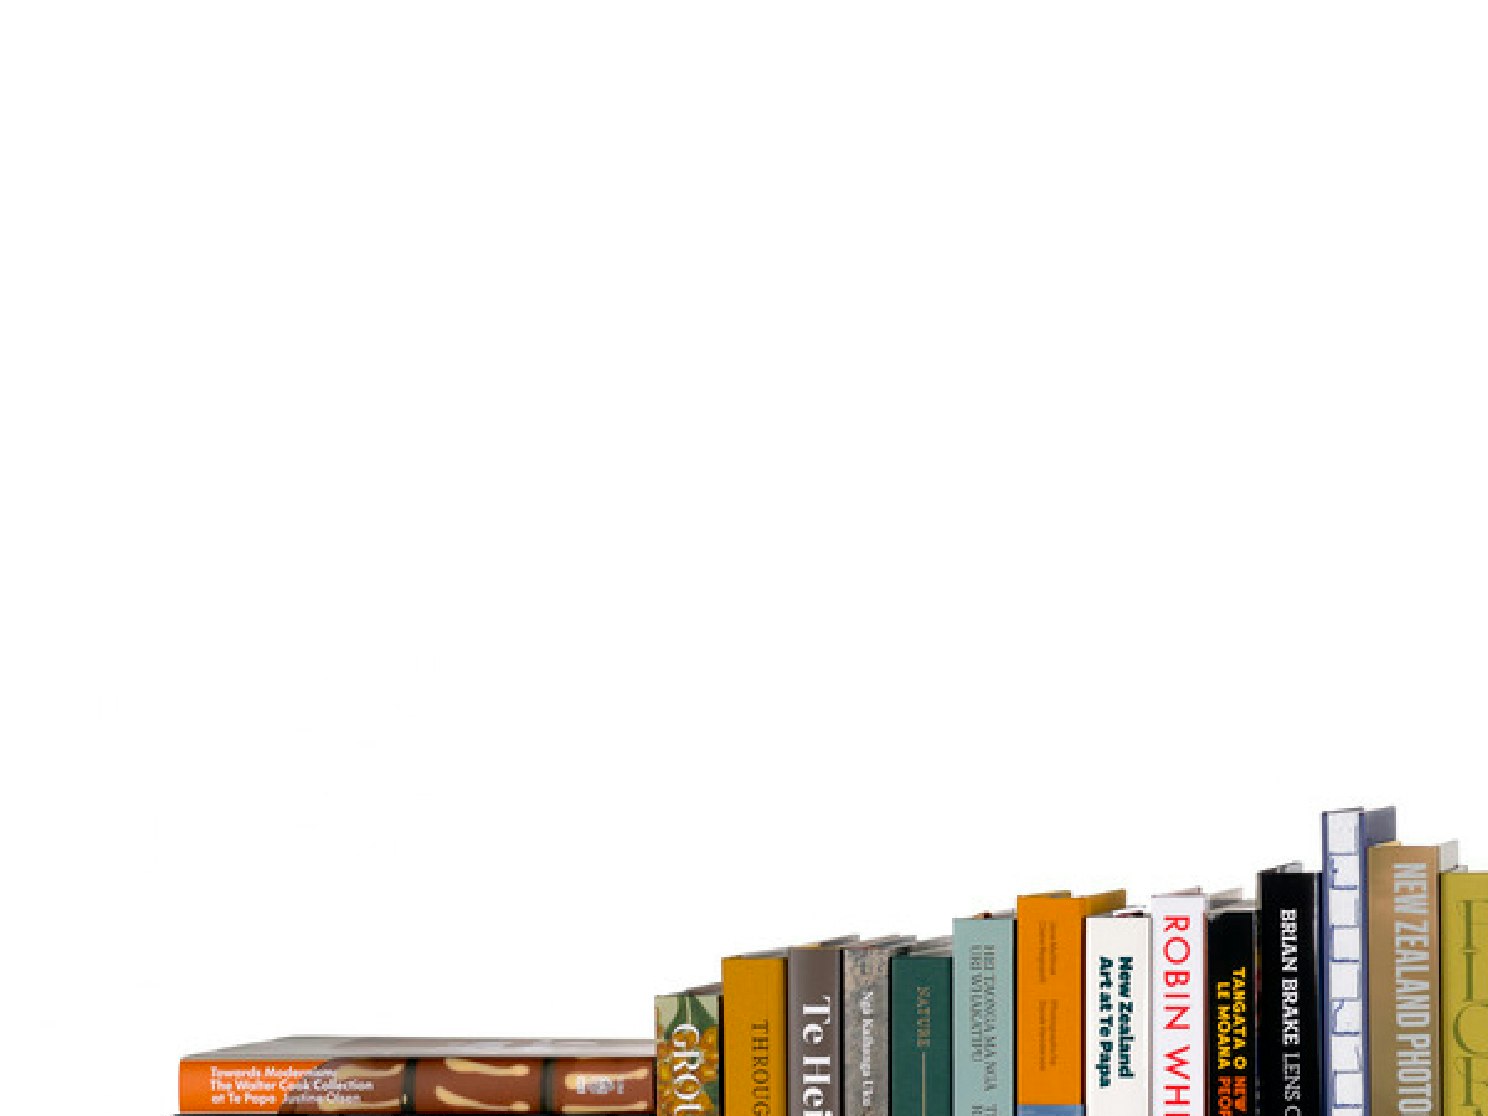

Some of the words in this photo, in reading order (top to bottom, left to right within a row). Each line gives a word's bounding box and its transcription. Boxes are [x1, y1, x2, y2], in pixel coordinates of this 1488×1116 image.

[1392, 863, 1429, 914] NEW
[1280, 908, 1298, 972] BRIAN
[1099, 956, 1113, 990] Art
[1118, 956, 1133, 998] New
[1163, 915, 1190, 1029] ROBIN
[1217, 981, 1230, 999] LE
[1394, 919, 1430, 1028] ZEALAND
[802, 994, 830, 1044] Te
[916, 986, 931, 1047] NATURE
[1099, 991, 1113, 1013] at
[1099, 1015, 1113, 1038] Te
[1232, 966, 1247, 1049] TANGATA
[1281, 977, 1300, 1045] BRAKE
[1118, 1001, 1136, 1079] Zealand
[1217, 1004, 1230, 1070] MOANA
[210, 1080, 233, 1090] The
[236, 1080, 275, 1090] Walter
[313, 1079, 374, 1091] Collection
[1095, 1041, 1113, 1088] Papa
[1234, 1056, 1247, 1070] O
[1283, 1052, 1301, 1102] LENS
[1234, 1076, 1247, 1112] NEW
